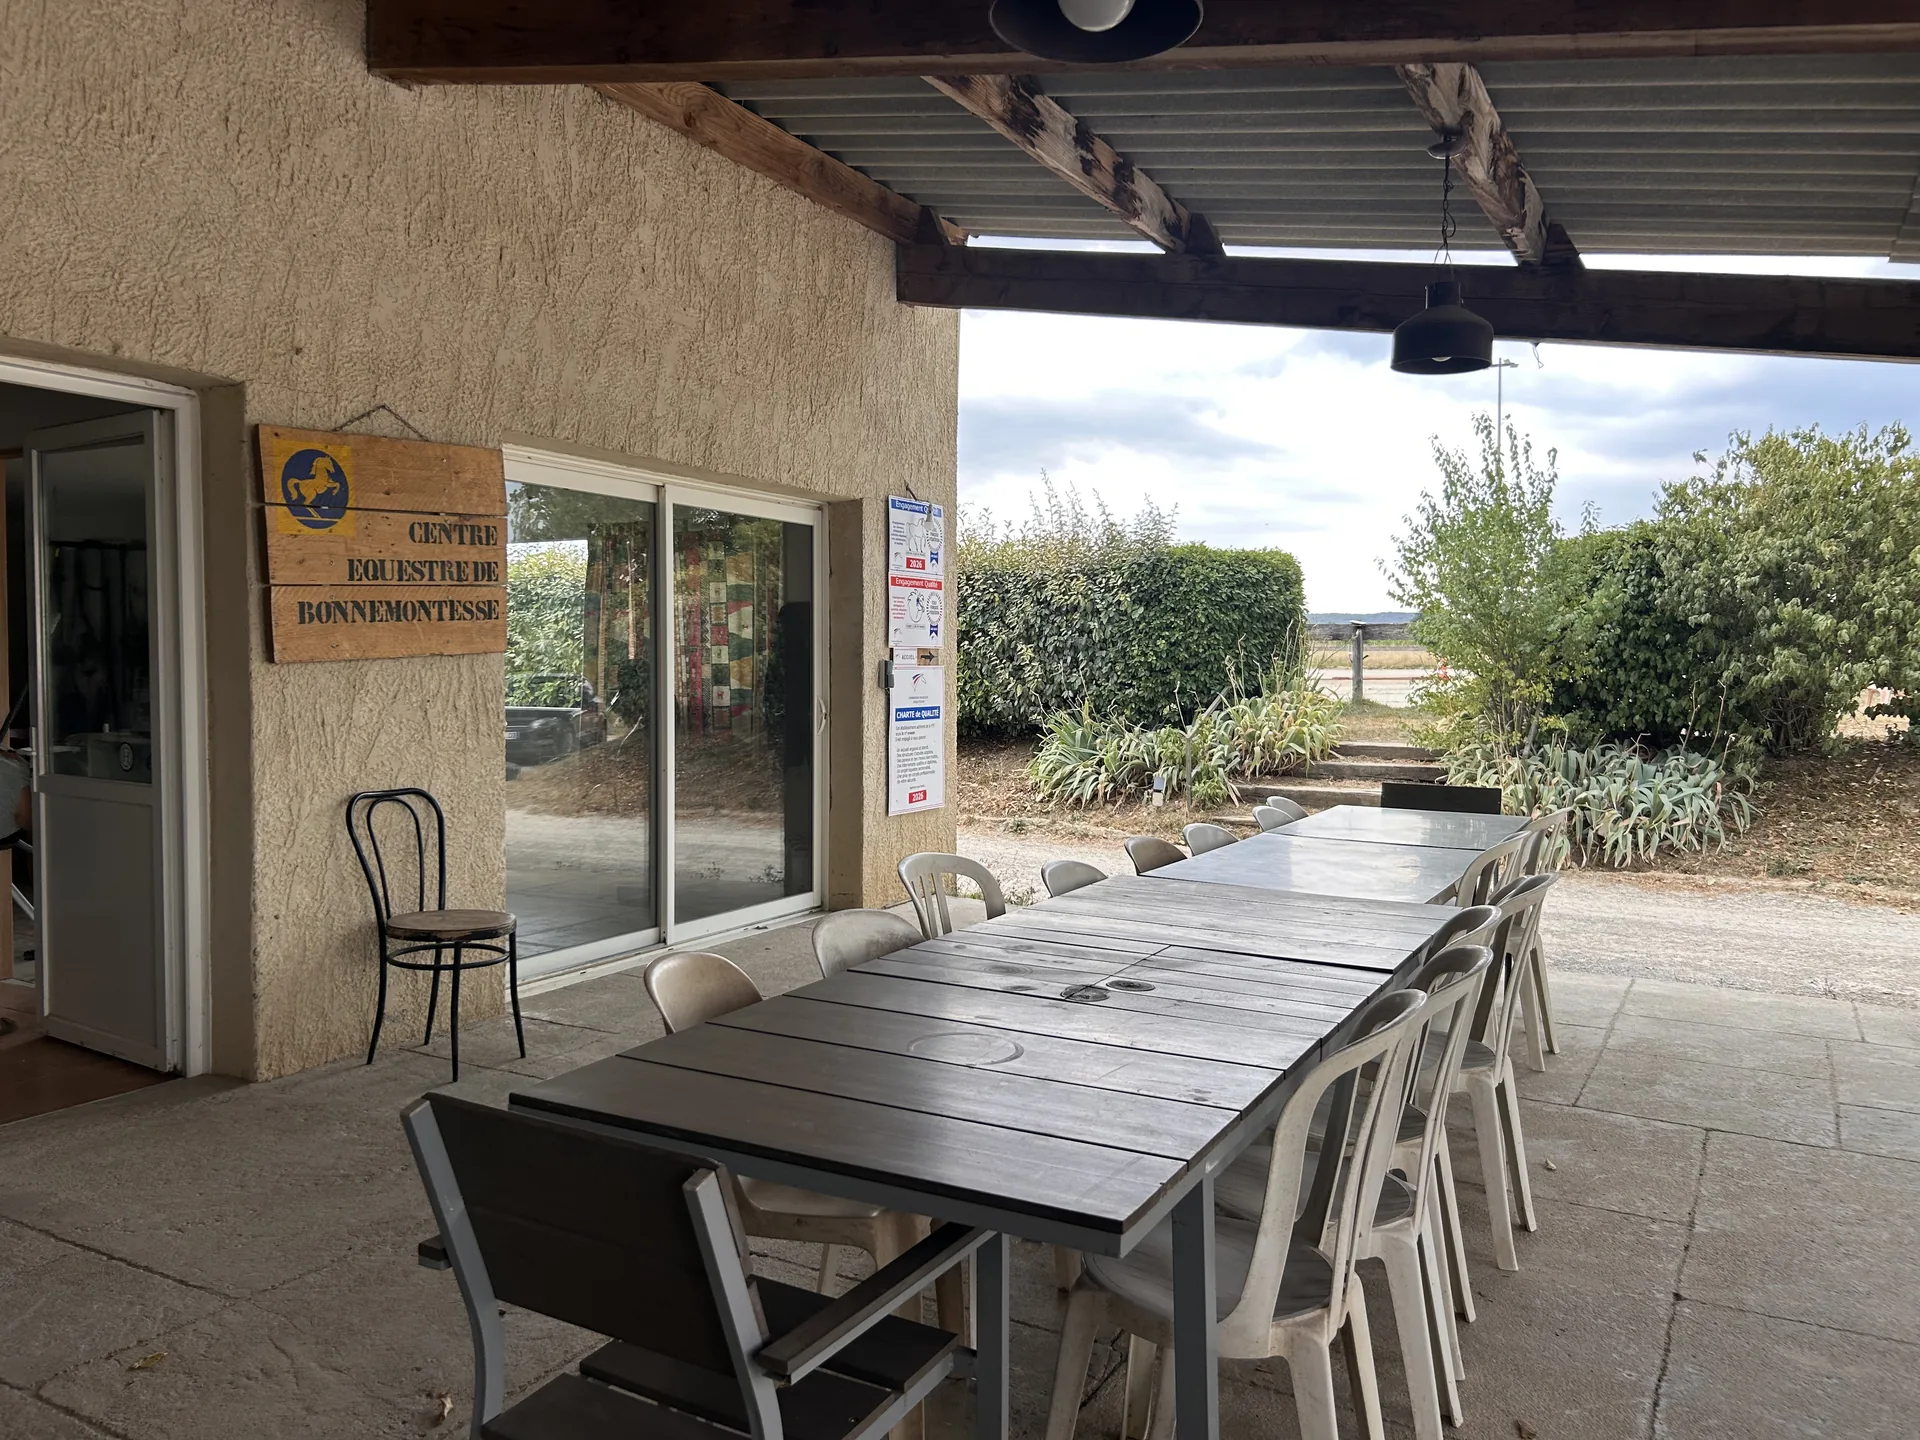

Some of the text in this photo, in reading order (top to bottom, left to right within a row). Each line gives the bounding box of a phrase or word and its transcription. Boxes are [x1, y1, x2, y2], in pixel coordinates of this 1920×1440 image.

[408, 521, 498, 546] CENTRE
[909, 559, 923, 568] 2026
[347, 558, 499, 583] EQUESTRE DE
[895, 577, 924, 588] Engagement
[297, 599, 500, 625] BONNEMONTESSE
[896, 707, 939, 719] CHARTE de QUALITÉ
[912, 791, 924, 802] 2026
